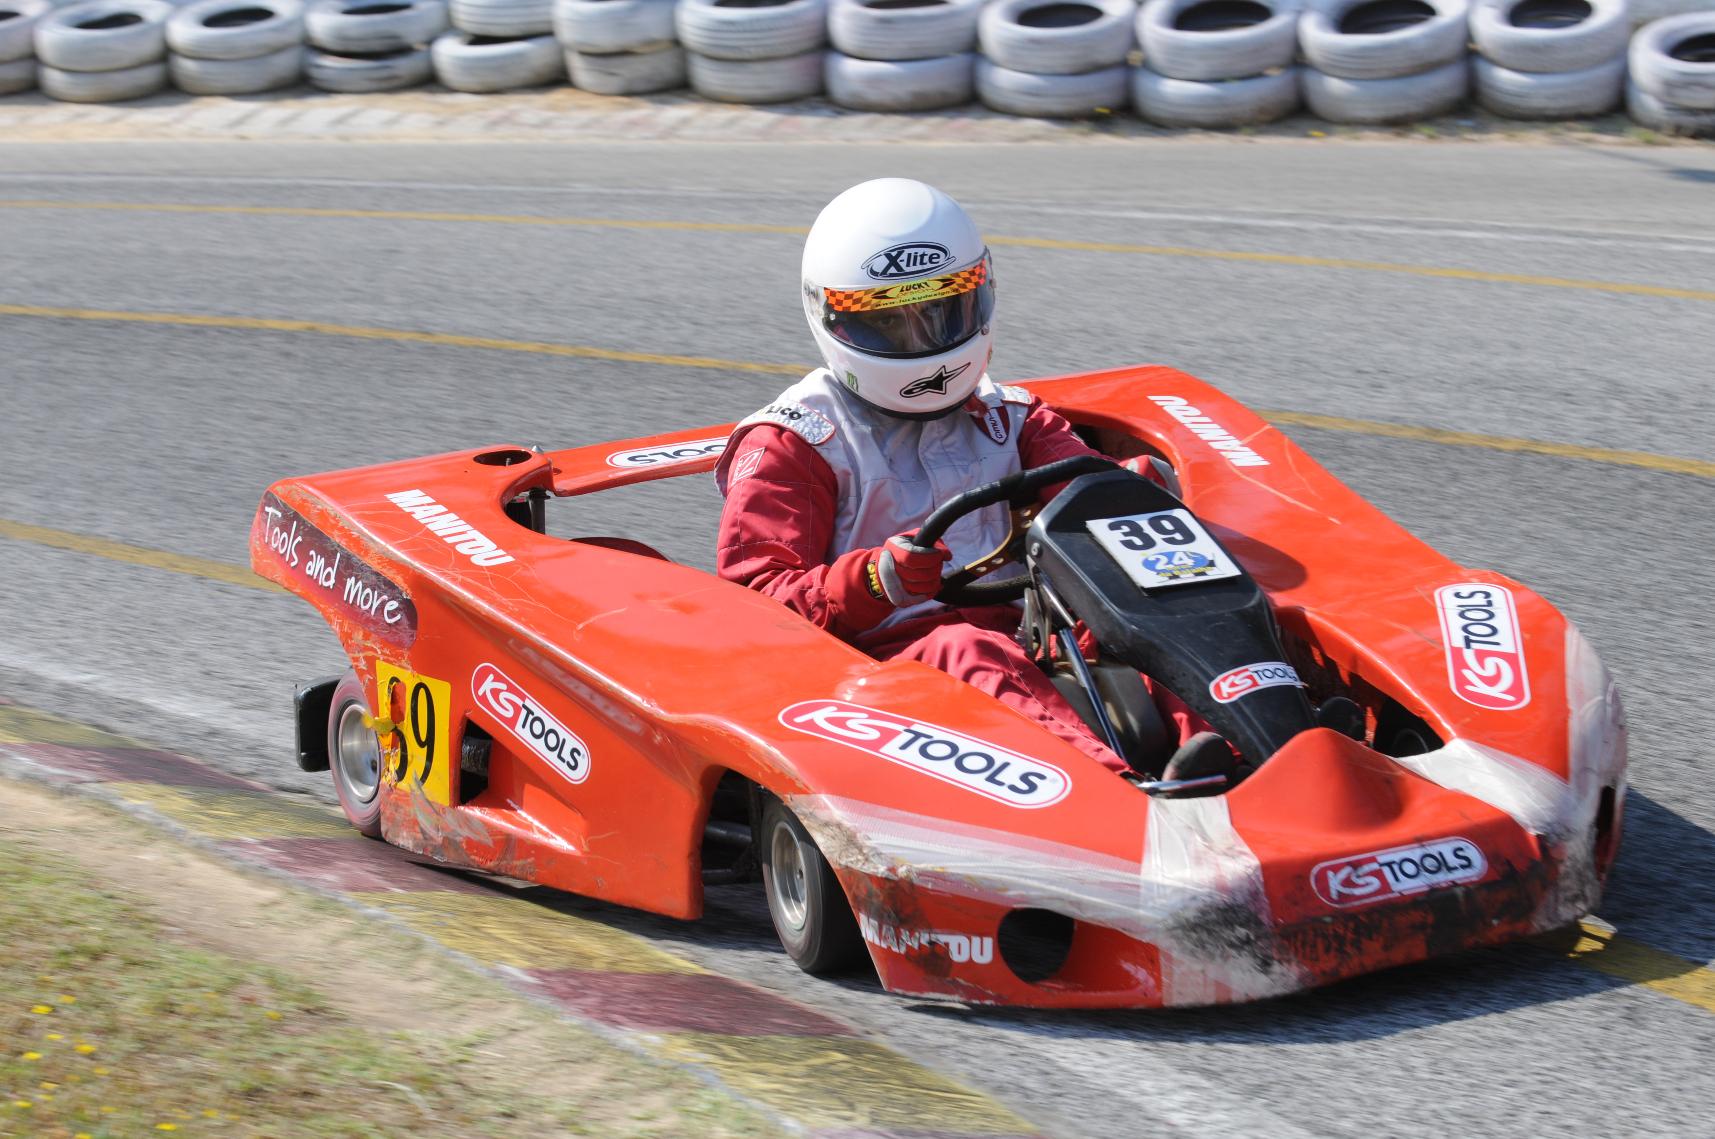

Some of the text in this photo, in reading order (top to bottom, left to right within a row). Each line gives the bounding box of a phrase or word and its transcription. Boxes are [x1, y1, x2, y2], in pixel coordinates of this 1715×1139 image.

[880, 249, 941, 276] X-lite
[899, 281, 930, 292] LUCKY
[1147, 395, 1270, 466] MANITOU
[628, 444, 727, 464] OOLS
[384, 489, 515, 567] MANITOU
[1107, 514, 1197, 551] 39
[263, 506, 402, 624] Tools and more
[1148, 551, 1195, 570] 24
